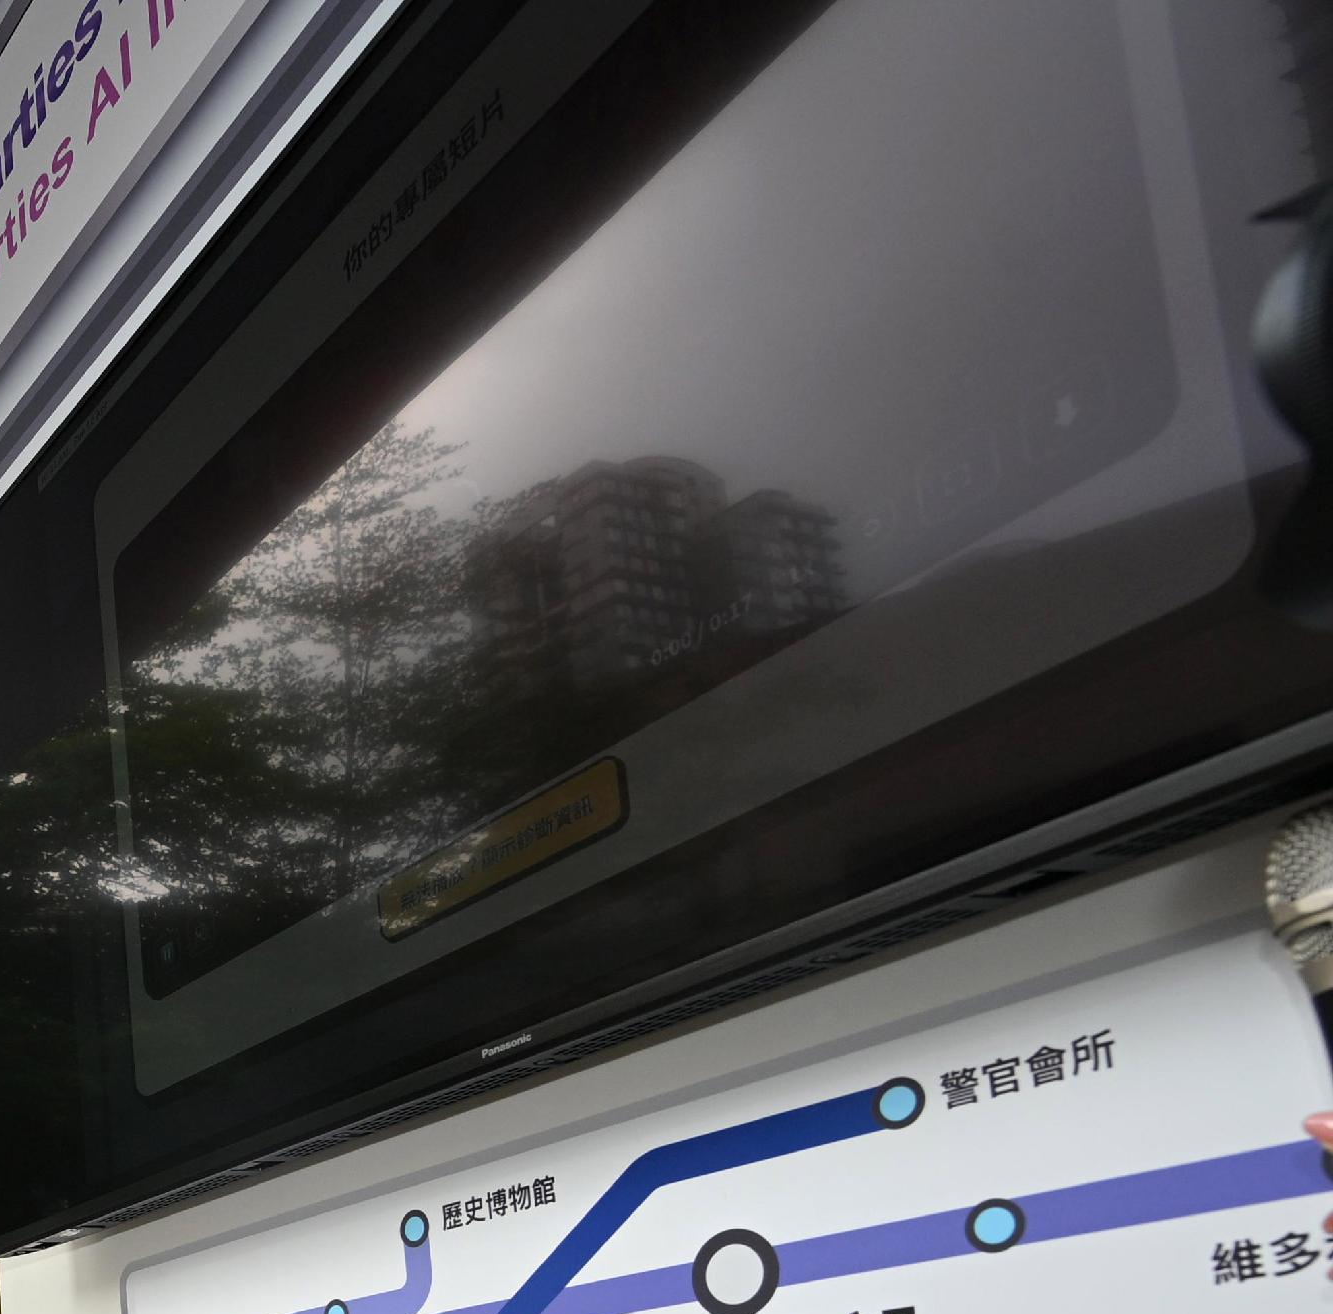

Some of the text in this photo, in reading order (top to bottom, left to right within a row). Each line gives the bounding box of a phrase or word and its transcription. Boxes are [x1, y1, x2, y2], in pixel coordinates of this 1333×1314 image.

[86, 30, 132, 145] AI
[481, 1033, 532, 1059] Panasonic
[939, 1028, 1116, 1110] 警官會所
[441, 1175, 558, 1232] 歷史博物館
